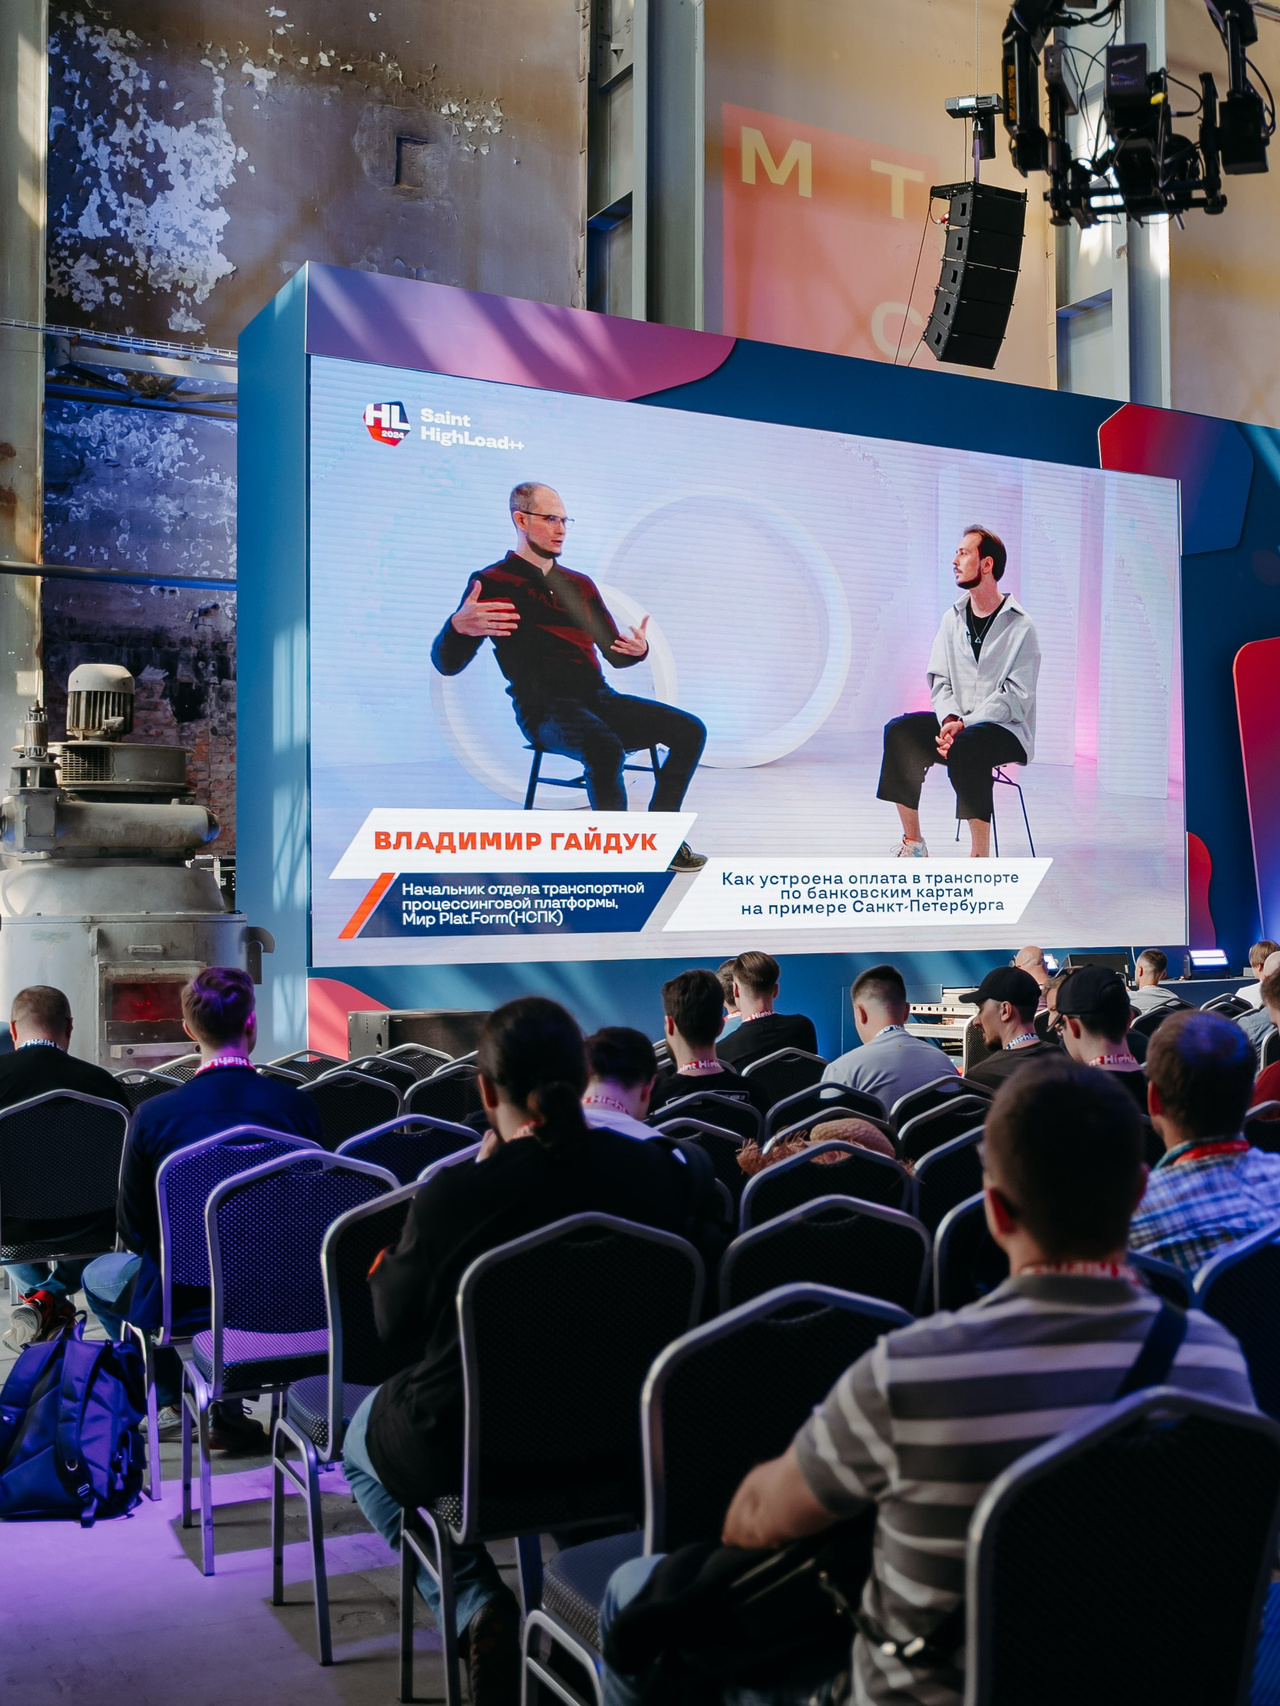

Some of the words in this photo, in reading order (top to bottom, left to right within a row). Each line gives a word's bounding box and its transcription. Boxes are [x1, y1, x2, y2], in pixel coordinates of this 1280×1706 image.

[365, 403, 411, 430] HL
[421, 408, 471, 427] Saint
[381, 430, 405, 439] 2024
[421, 426, 524, 450] HighLoad++
[374, 831, 542, 854] ВЛАДИМИР
[550, 827, 658, 854] ГАЙДУК
[402, 883, 485, 895] Начальник
[488, 884, 540, 896] отдела
[542, 882, 645, 896] транспортной
[722, 872, 755, 886] Как
[759, 874, 844, 889] устроена
[848, 873, 908, 885] оплата
[912, 873, 921, 884] в
[925, 872, 1019, 887] транспорте
[781, 888, 802, 899] по
[807, 885, 912, 899] банковским
[916, 887, 974, 900] картам
[402, 898, 532, 911] процессинговой
[534, 896, 618, 911] платформы,
[742, 903, 763, 915] на
[768, 902, 847, 917] примере
[852, 899, 1005, 915] Санкт-Петербурга
[402, 912, 436, 927] Мир
[439, 909, 563, 926] Plat.Form(НСПК)
